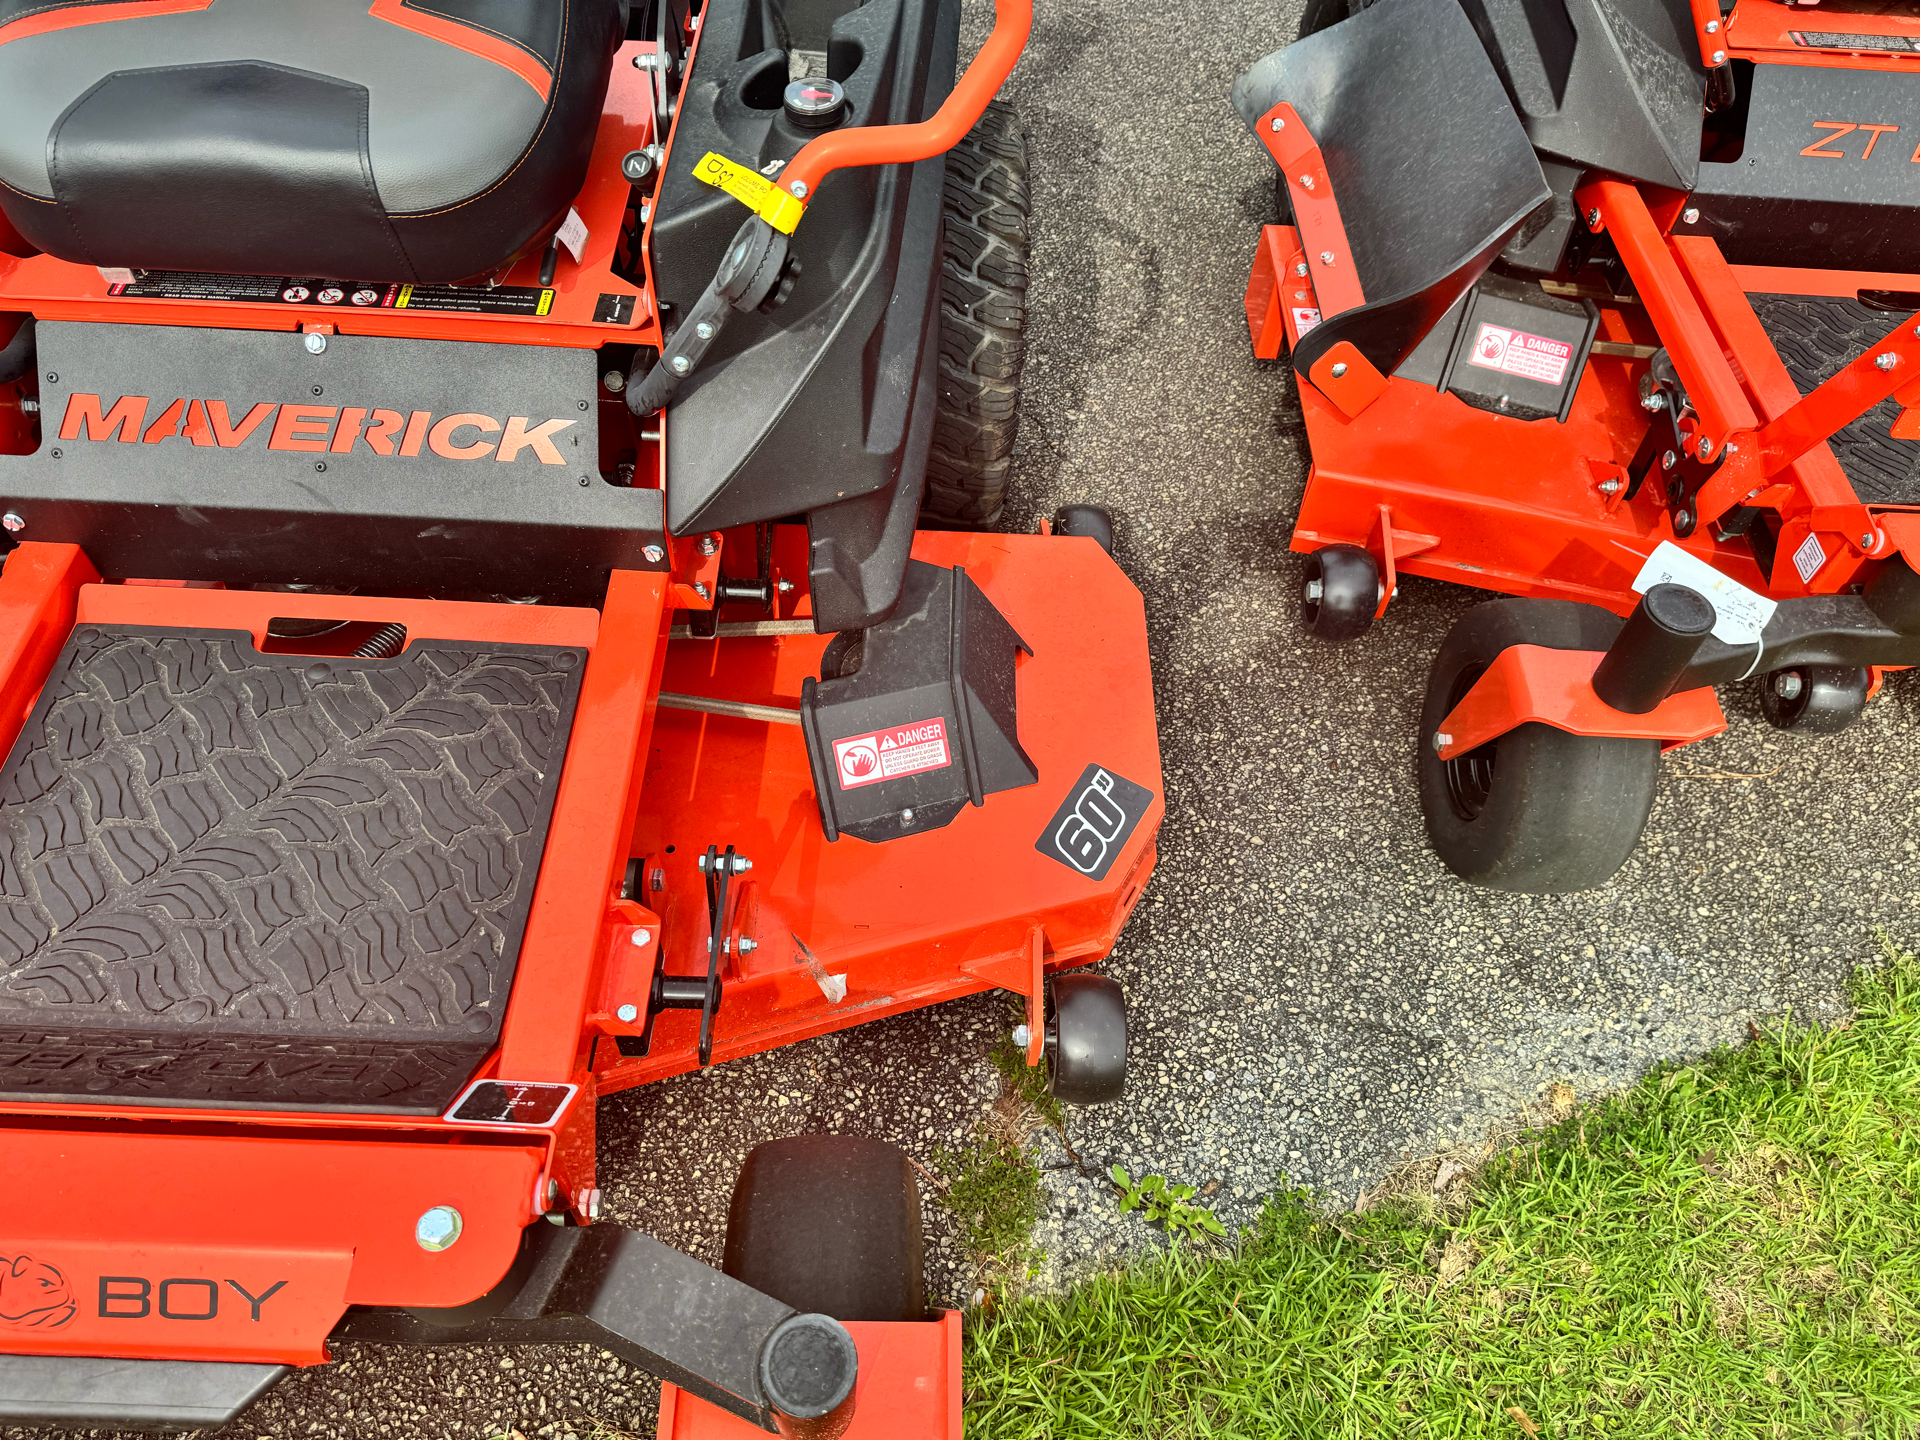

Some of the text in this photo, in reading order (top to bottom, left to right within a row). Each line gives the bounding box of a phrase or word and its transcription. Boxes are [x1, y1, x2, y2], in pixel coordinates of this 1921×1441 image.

[1800, 121, 1900, 160] ZT
[1527, 338, 1568, 356] DANGER
[59, 392, 577, 465] MAVERICK
[897, 724, 942, 746] DANGER
[902, 750, 922, 759] OPERATE
[923, 746, 940, 754] MOWER
[926, 751, 942, 759] GRASS
[889, 765, 910, 773] CATCHER
[98, 1275, 289, 1322] BOY
